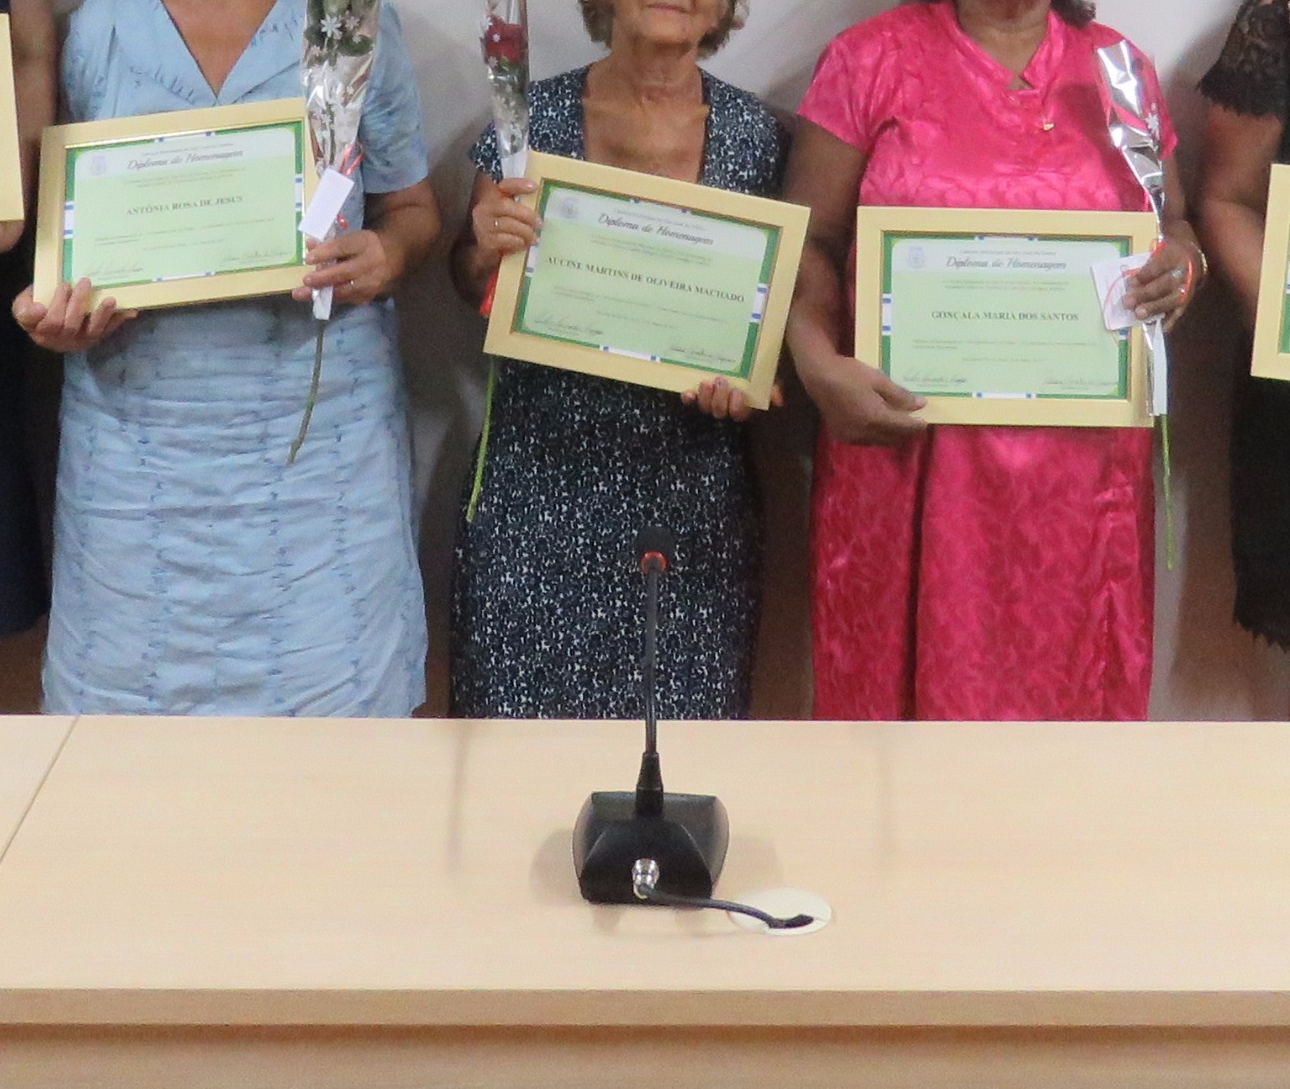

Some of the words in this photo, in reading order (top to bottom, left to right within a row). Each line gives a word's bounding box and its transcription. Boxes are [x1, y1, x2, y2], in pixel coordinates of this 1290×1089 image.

[125, 203, 171, 216] ANTÔNIA
[171, 200, 198, 211] ROSA
[199, 199, 213, 208] DE
[215, 195, 244, 205] JESUS
[597, 212, 640, 230] Diploma
[641, 223, 654, 234] de
[656, 224, 715, 246] Homenagem
[945, 256, 988, 269] Diploma
[991, 257, 1003, 268] de
[584, 262, 629, 280] MARTINS
[631, 272, 643, 282] DE
[646, 275, 693, 293] OLIVEIRA
[694, 285, 746, 303] MACHADO
[931, 311, 981, 321] GONÇALA
[982, 311, 1017, 320] MARIA
[1019, 311, 1039, 320] DOS
[1040, 312, 1079, 321] SANTOS
